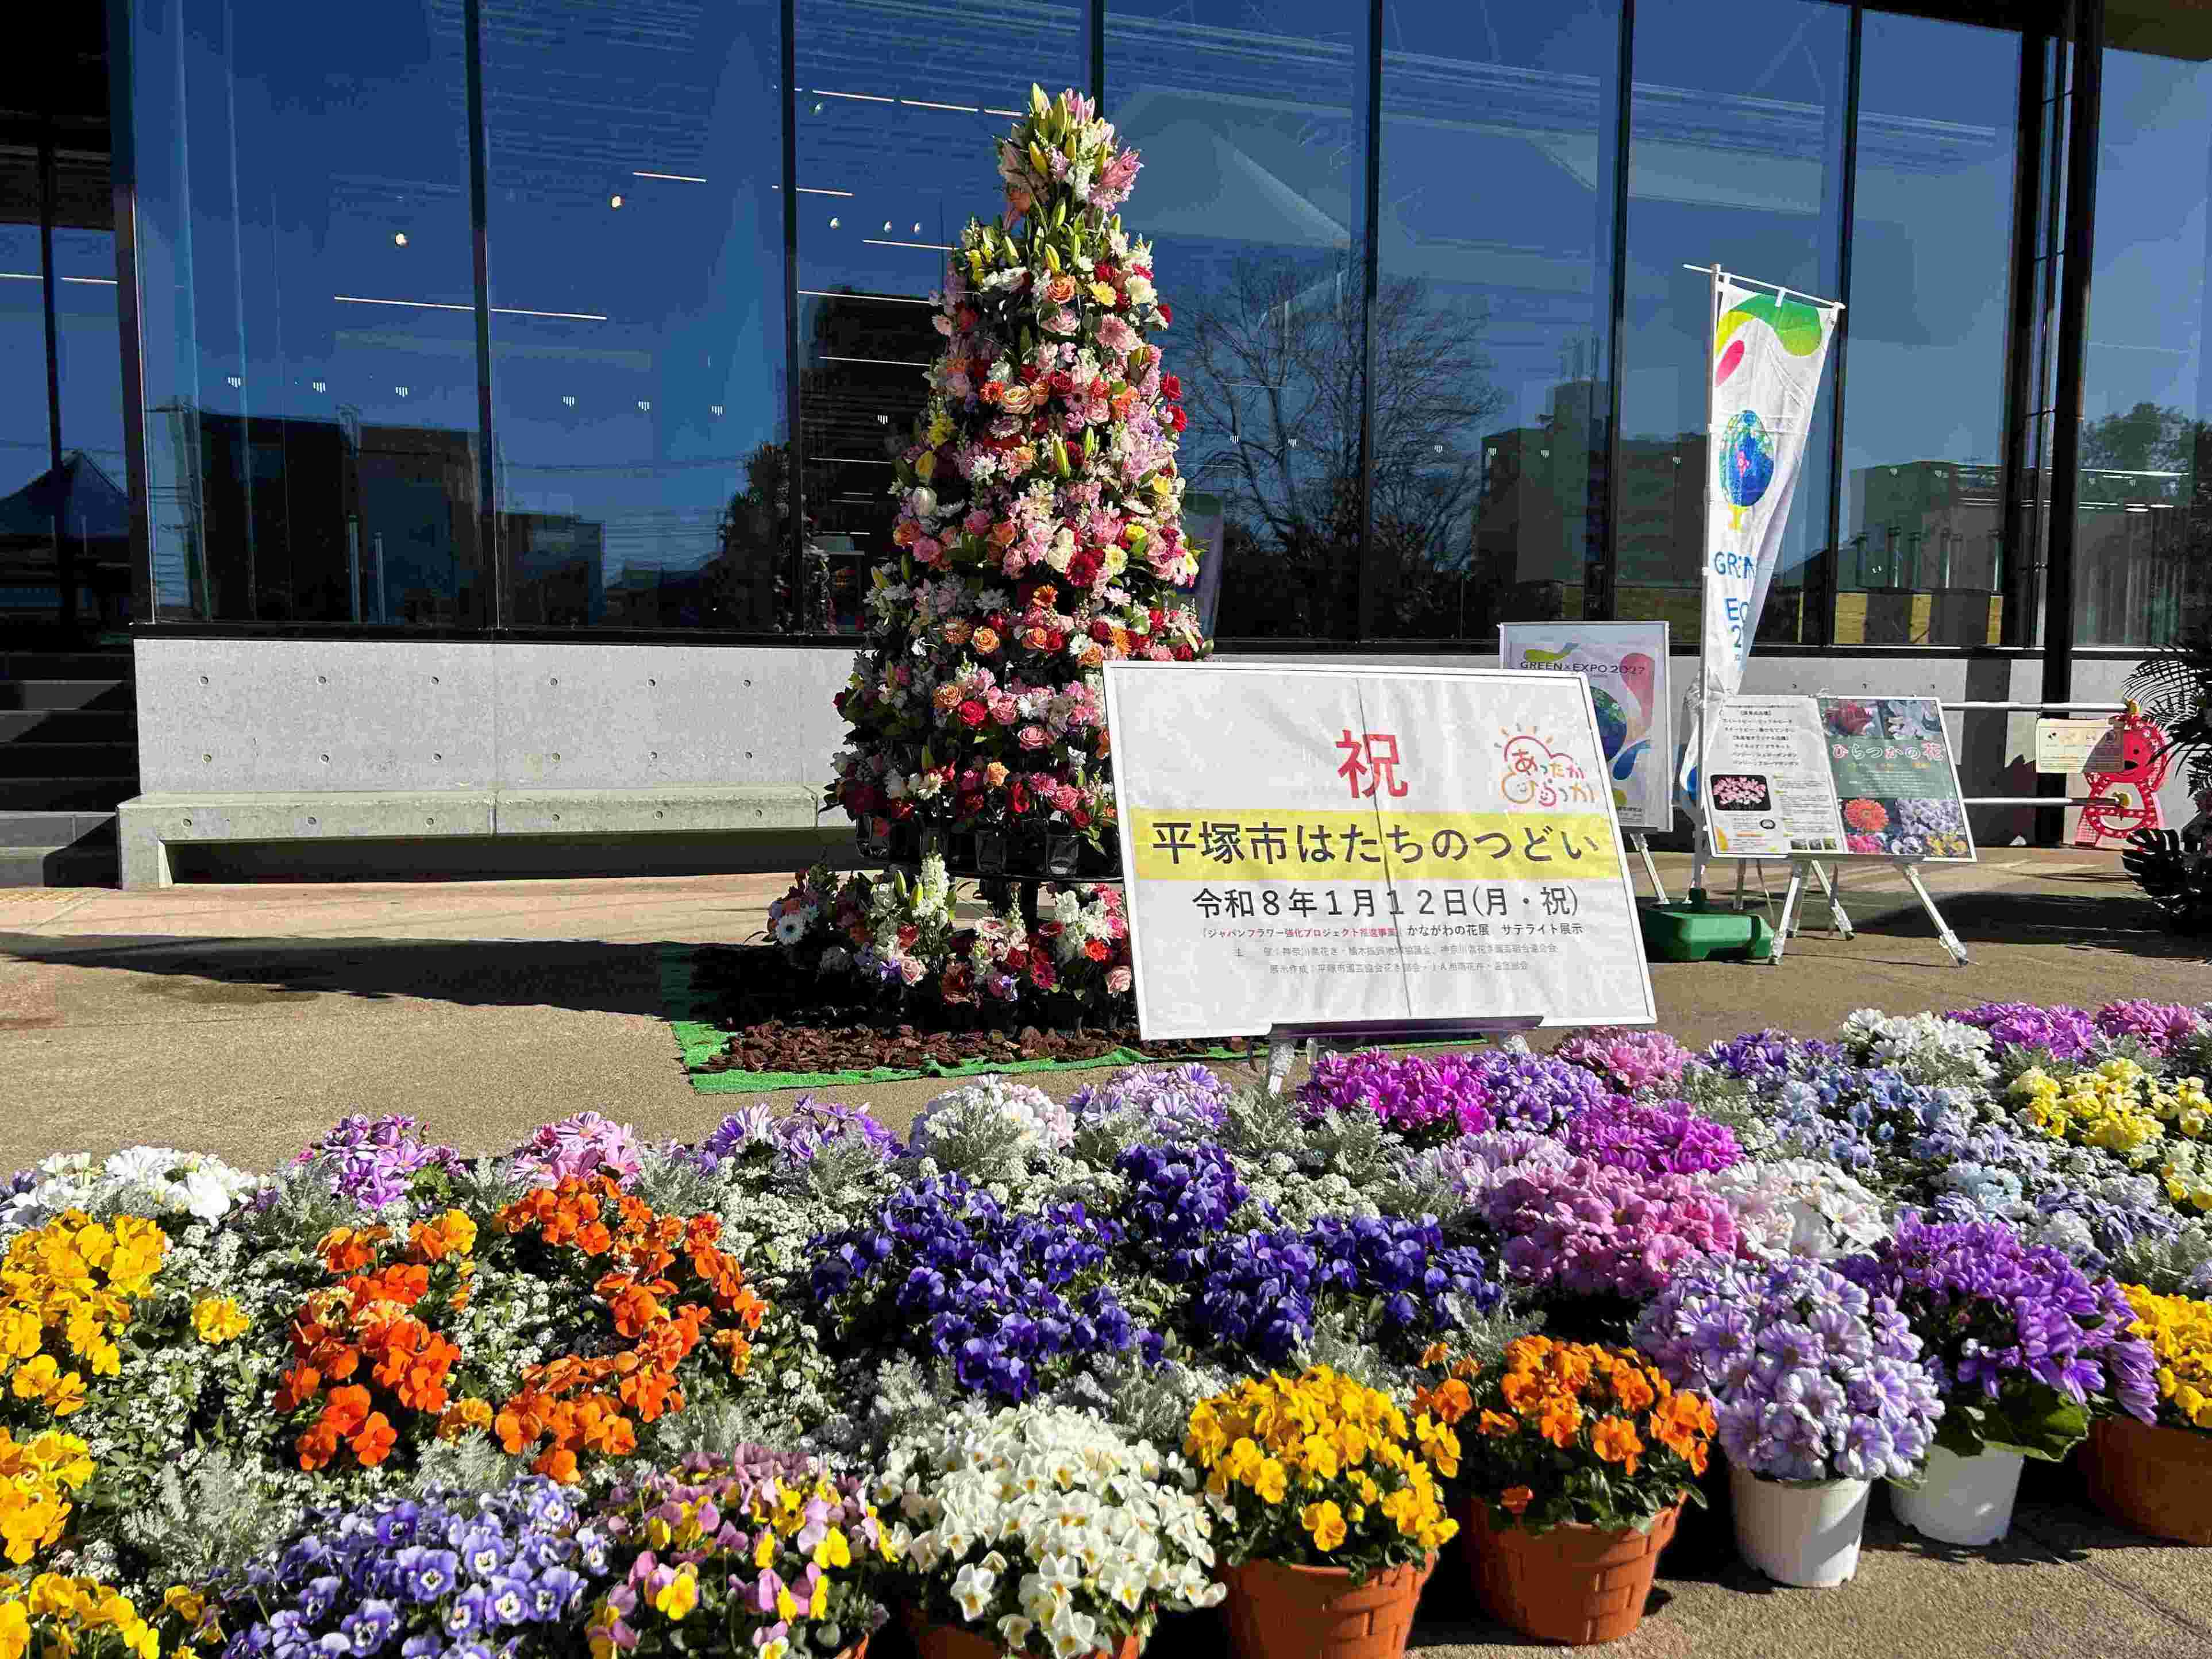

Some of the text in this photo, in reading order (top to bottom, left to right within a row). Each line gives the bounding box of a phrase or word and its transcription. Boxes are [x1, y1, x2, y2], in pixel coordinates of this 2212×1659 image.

[1336, 729, 1408, 798] 祝
[1833, 742, 1945, 761] ひらつかの花
[1153, 821, 1599, 864] 平塚市はたちのつどい
[1501, 923, 1584, 936] サテライト展示
